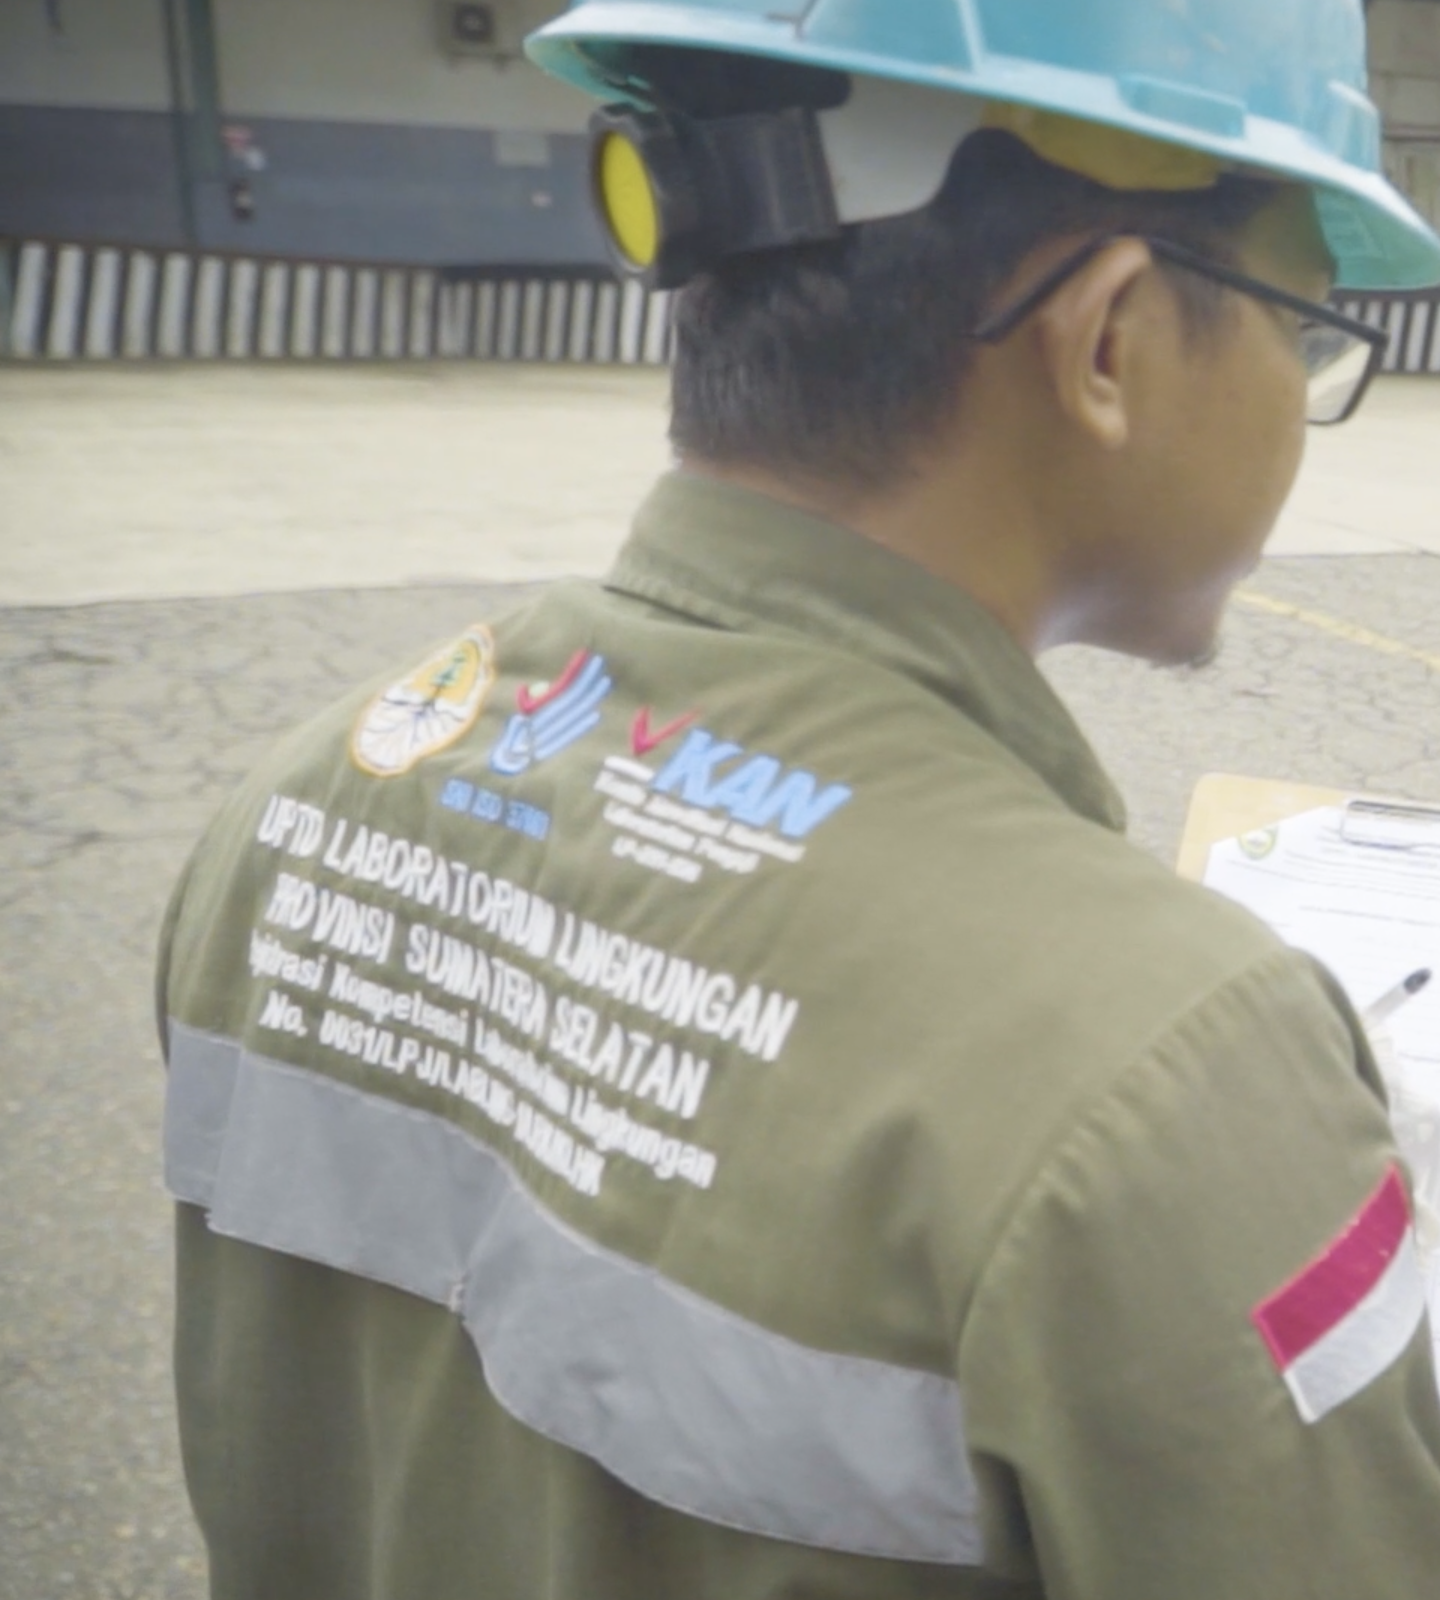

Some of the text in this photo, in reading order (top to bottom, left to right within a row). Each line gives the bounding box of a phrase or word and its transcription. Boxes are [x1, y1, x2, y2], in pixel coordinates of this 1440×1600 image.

[653, 727, 853, 838] KAN
[258, 989, 308, 1038] No.
[323, 817, 556, 959] LABORATORIUM
[554, 911, 799, 1062] LINGKUNGAN
[405, 923, 547, 1041] SUMATERA
[550, 995, 710, 1119] SELATAN
